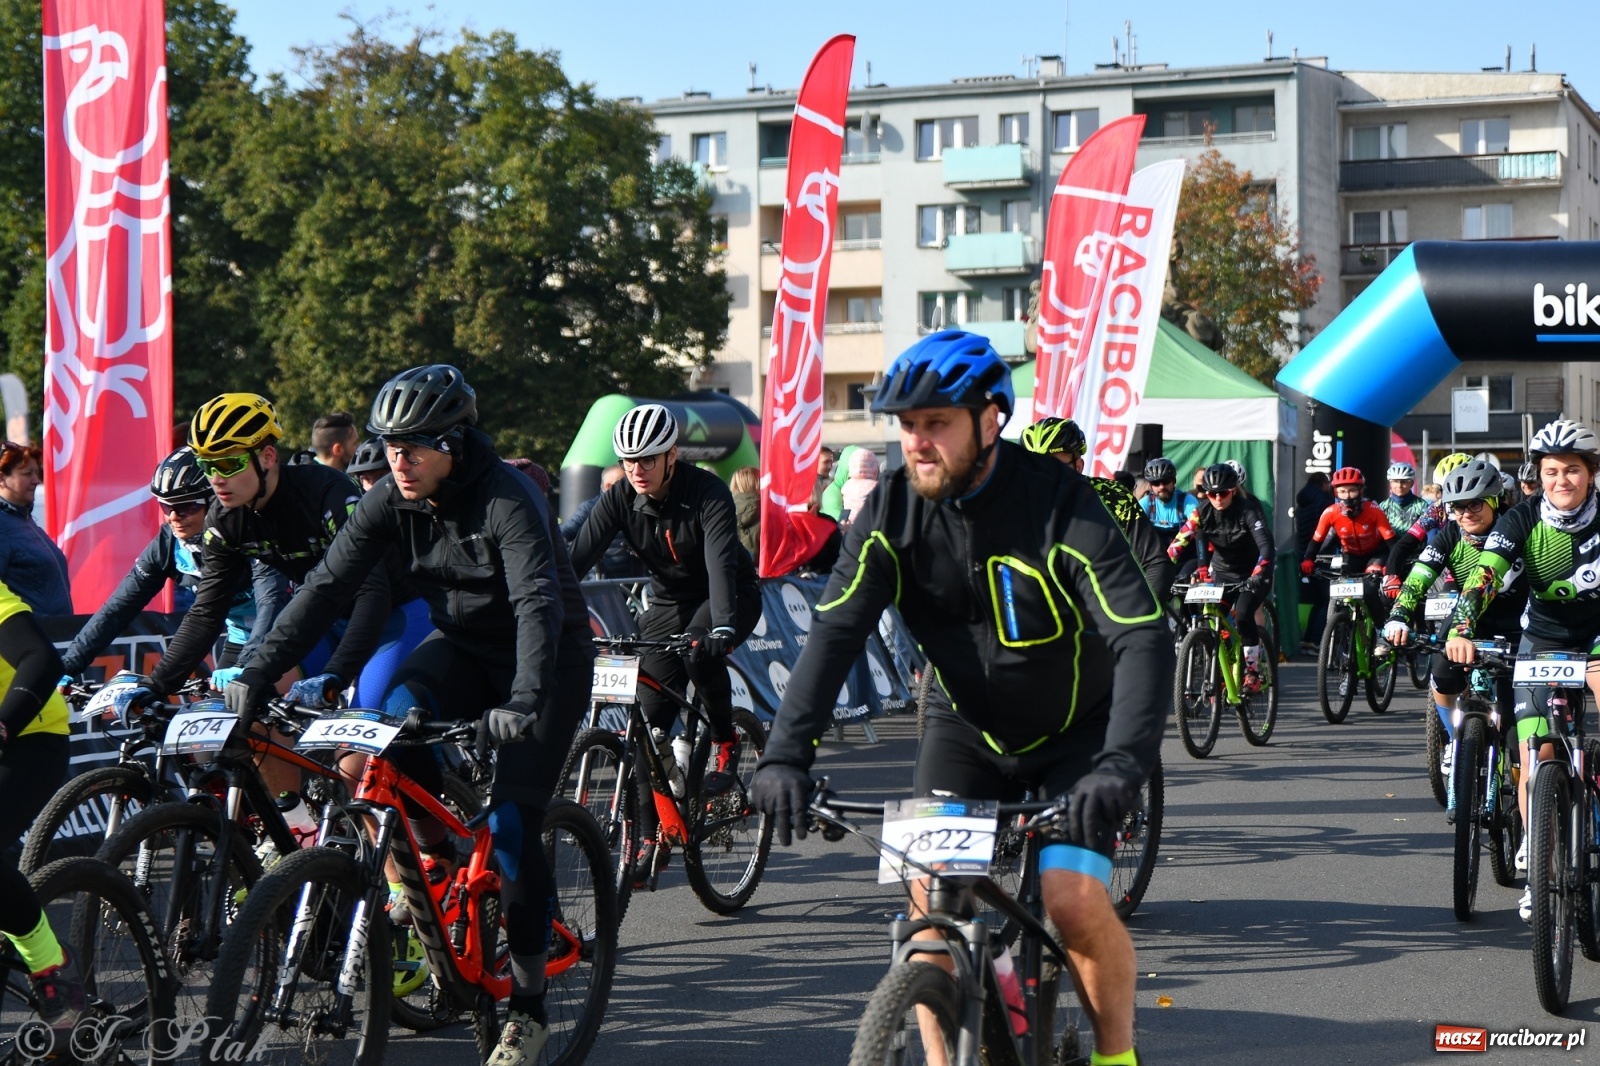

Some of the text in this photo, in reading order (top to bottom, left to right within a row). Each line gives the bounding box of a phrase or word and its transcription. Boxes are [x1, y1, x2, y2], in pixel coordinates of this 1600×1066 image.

[1336, 586, 1358, 594] 1261
[746, 638, 784, 652] KOKOwear
[1528, 666, 1575, 678] 1570
[832, 704, 869, 720] KOKOwear
[178, 719, 223, 737] 2674
[320, 723, 380, 740] 1656
[901, 828, 972, 852] 2822
[137, 911, 168, 979] MAXXIS
